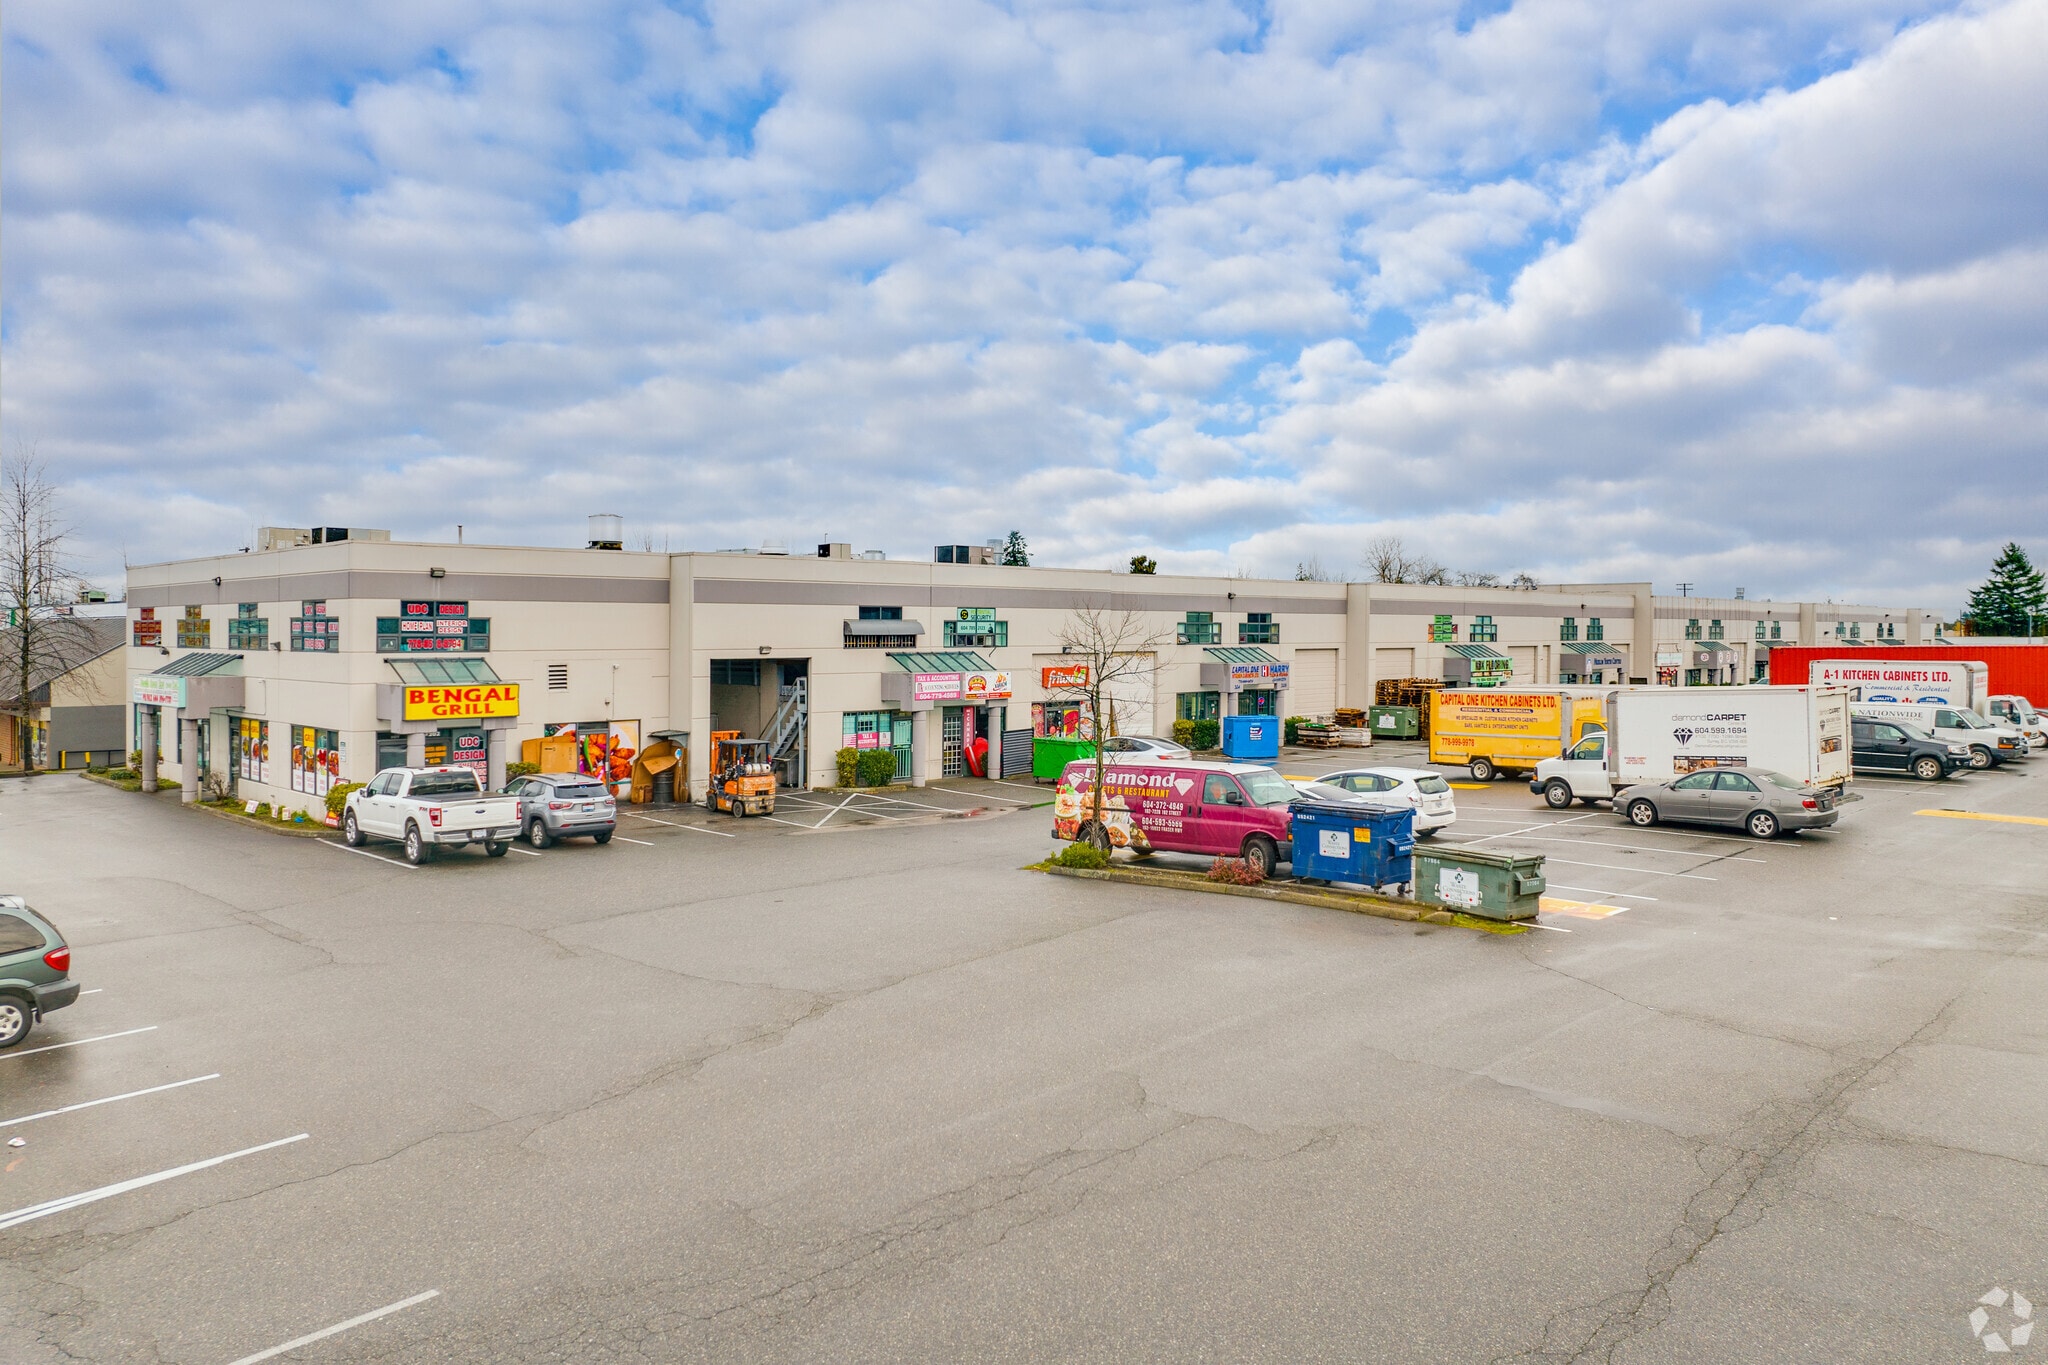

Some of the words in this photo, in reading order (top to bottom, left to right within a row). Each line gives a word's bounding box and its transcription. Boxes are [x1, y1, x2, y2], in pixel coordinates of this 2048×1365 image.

[407, 603, 429, 615] UDC
[439, 605, 465, 615] DESIGN
[1232, 665, 1249, 674] CAPITAL
[1251, 665, 1259, 673] ONE
[1270, 665, 1289, 673] HARRY
[1824, 669, 1839, 680] A-1
[1842, 669, 1880, 681] KITCHEN
[1883, 670, 1928, 682] CABINETS
[1931, 671, 1952, 682] LTD.
[1864, 683, 1902, 691] Commercial
[1912, 684, 1950, 693] Residential
[409, 687, 516, 705] BENGAL
[1440, 694, 1465, 706] CAPITAL
[1466, 694, 1479, 706] ONE
[1480, 694, 1508, 707] KITCHEN
[1509, 695, 1541, 708] CABINETS
[1542, 696, 1557, 709] LTD.
[432, 703, 495, 716] GRILL
[1859, 709, 1923, 719] NATIONWIDE
[460, 737, 479, 747] UDC
[454, 751, 485, 761] DESIGN
[1117, 786, 1122, 795] &
[1124, 787, 1170, 798] RESTAURANT
